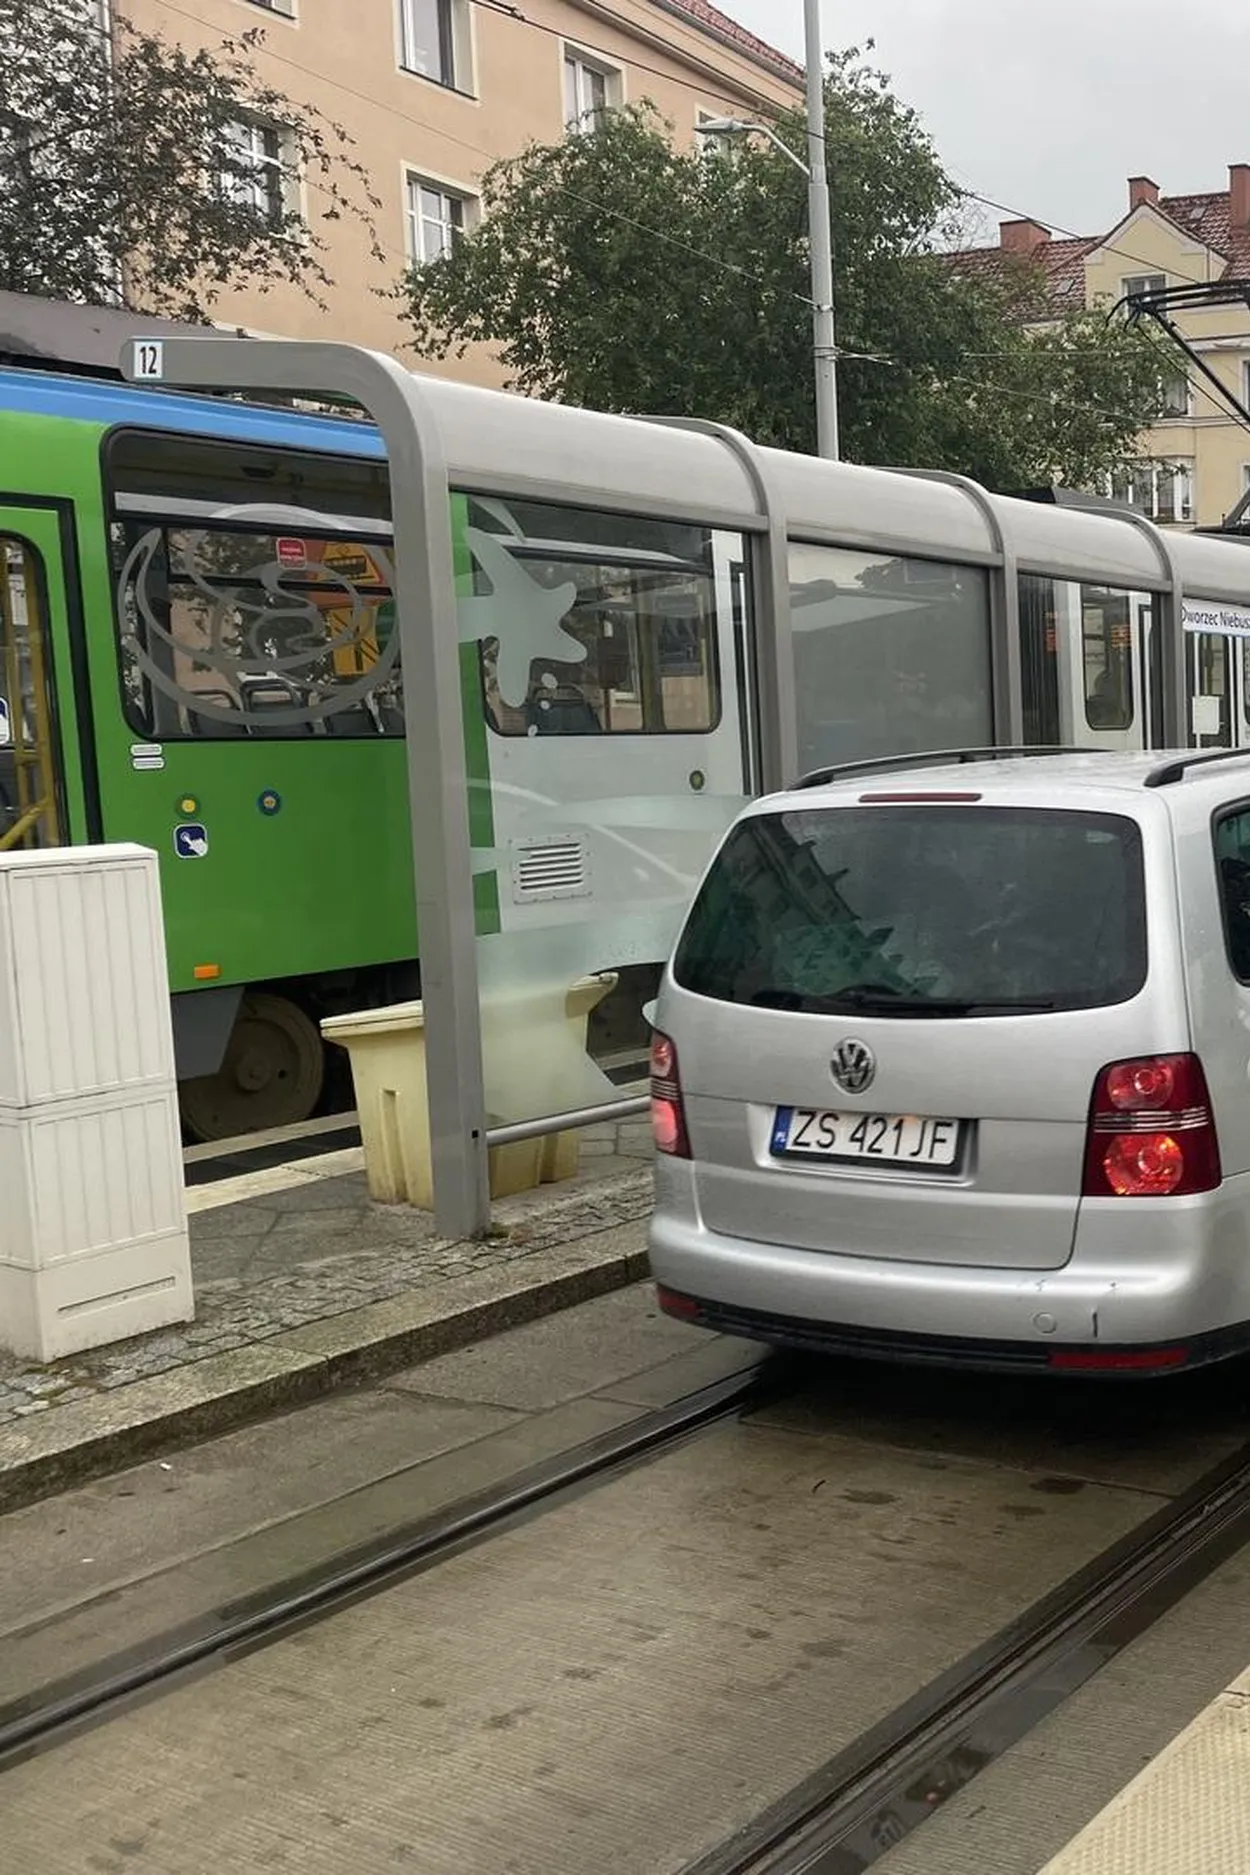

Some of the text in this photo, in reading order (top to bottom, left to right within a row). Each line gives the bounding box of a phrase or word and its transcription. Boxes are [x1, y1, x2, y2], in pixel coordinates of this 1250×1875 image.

[139, 346, 157, 374] 12
[1181, 606, 1218, 626] Dworzec
[792, 1110, 840, 1149] ZS
